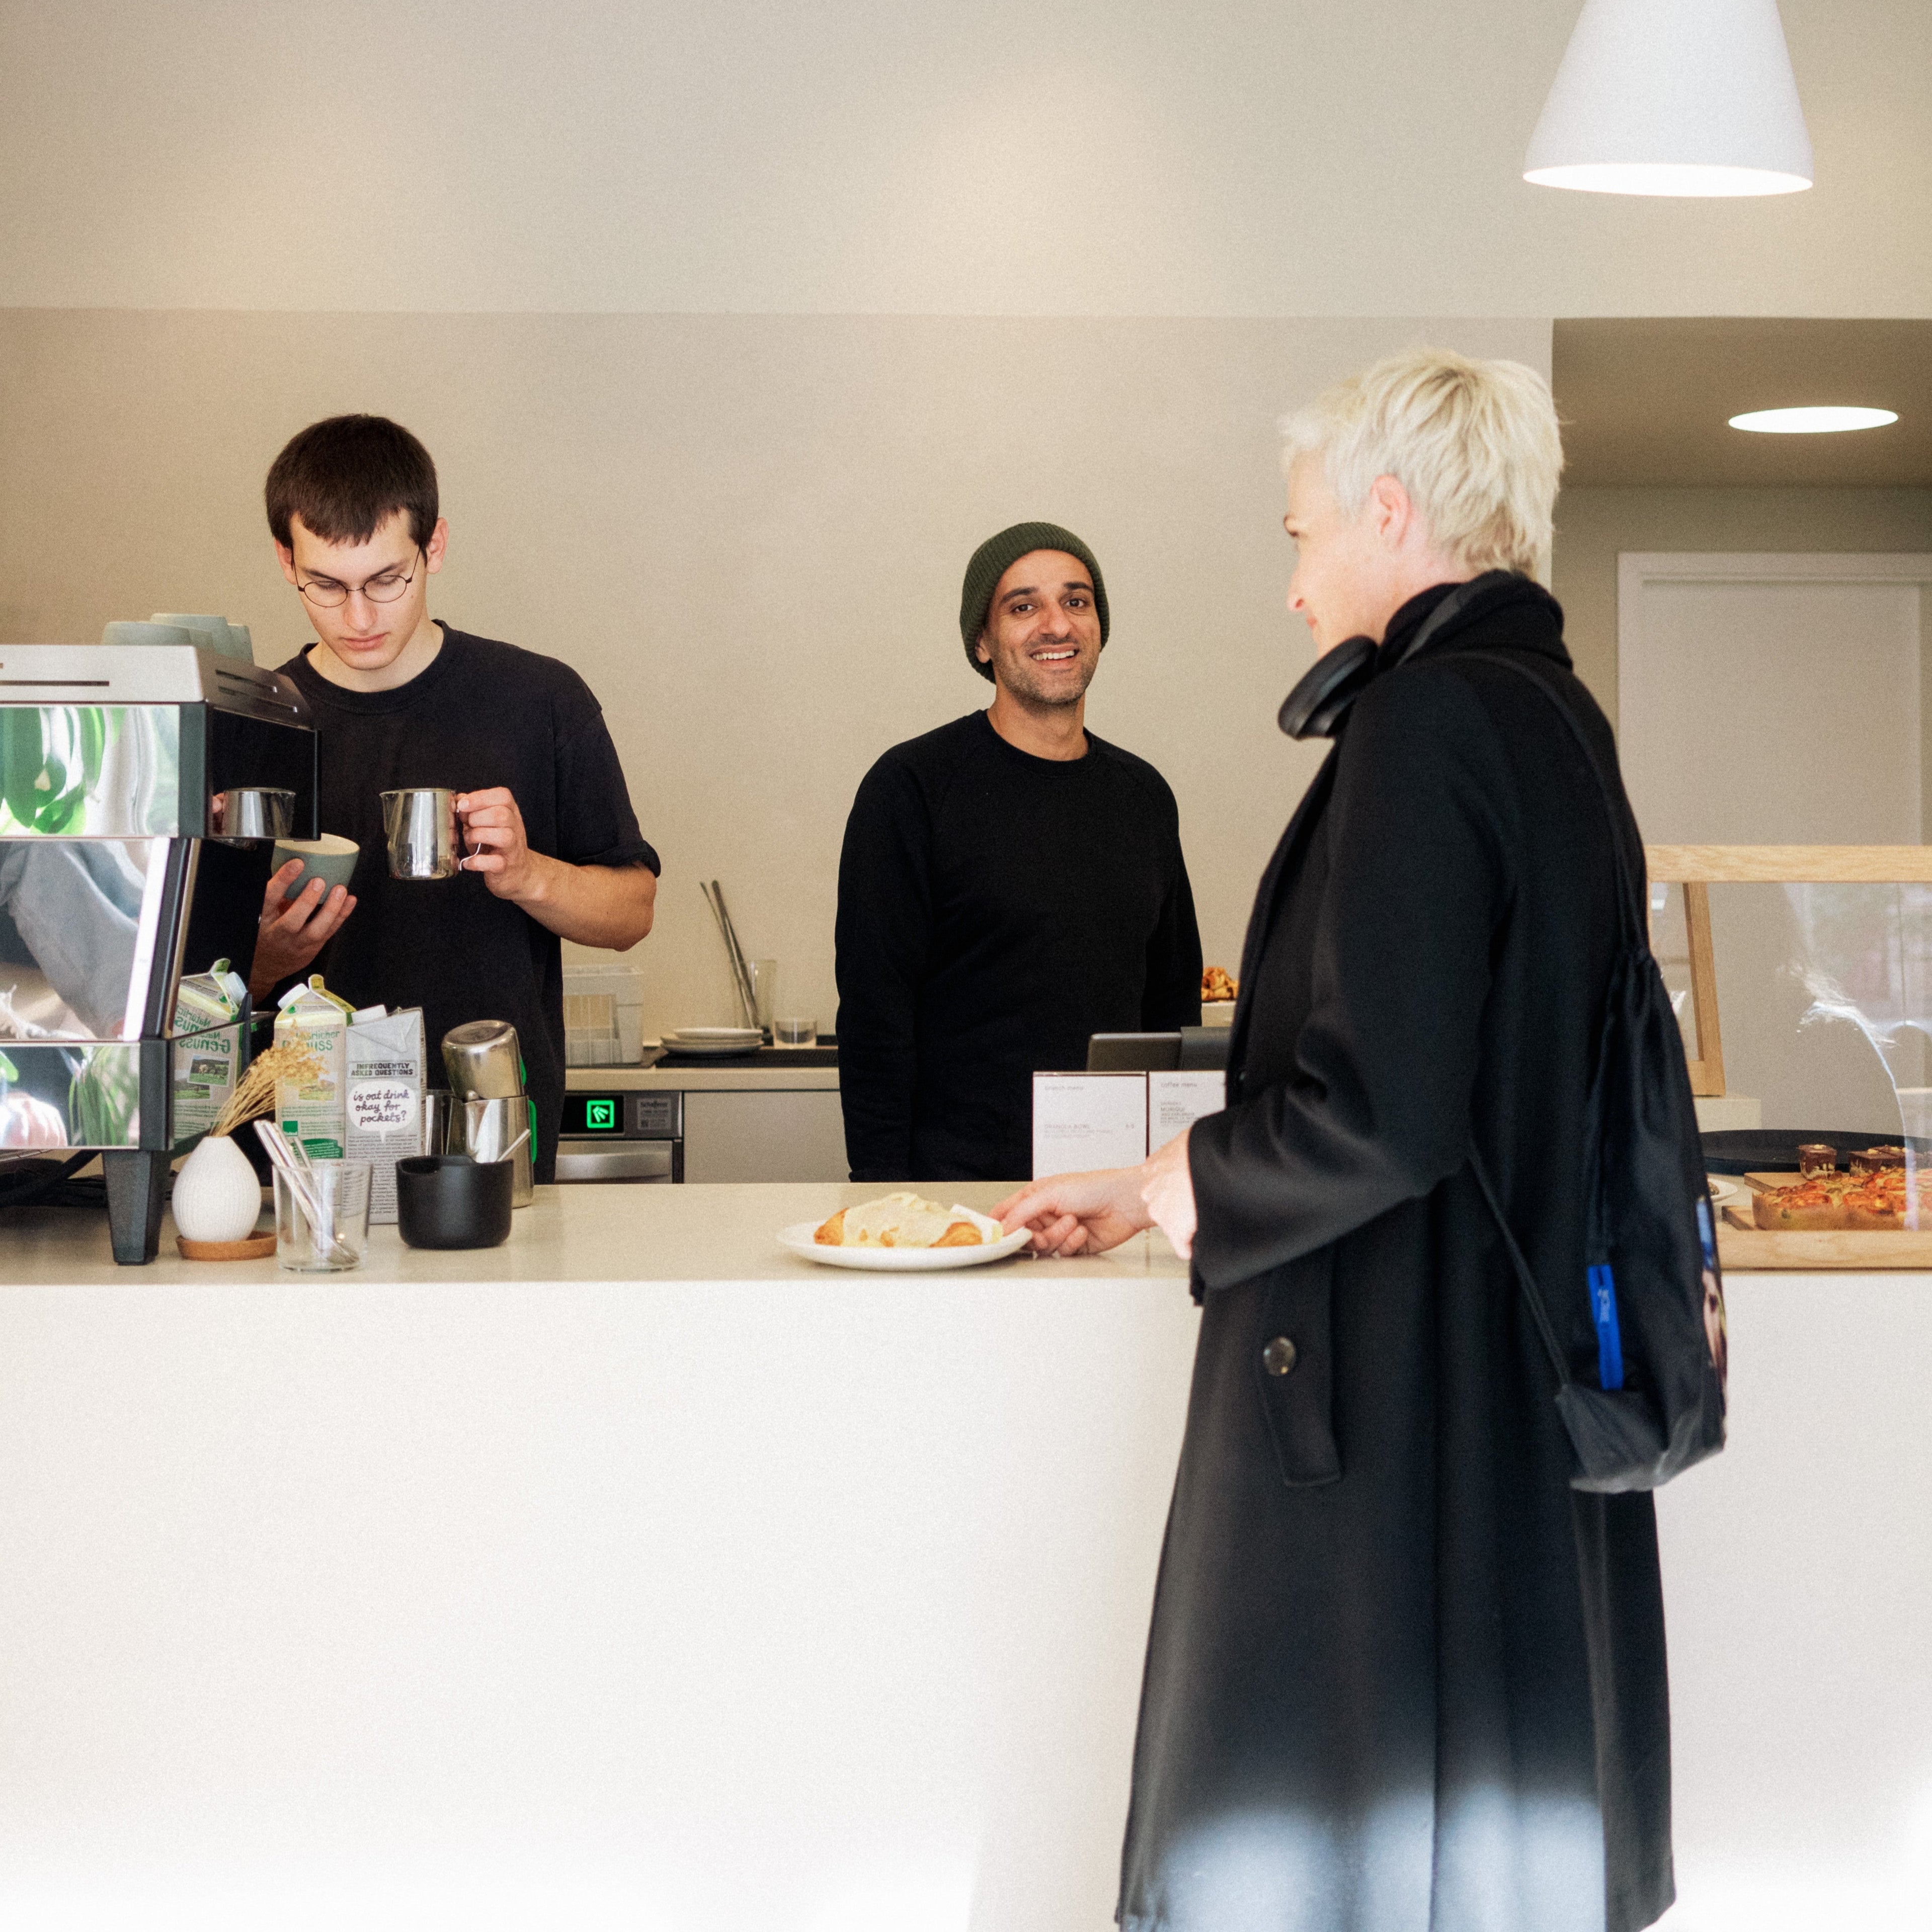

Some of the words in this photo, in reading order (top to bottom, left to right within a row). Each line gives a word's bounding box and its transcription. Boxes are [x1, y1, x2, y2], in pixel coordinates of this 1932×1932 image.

[353, 1091, 364, 1101] is
[366, 1090, 382, 1101] oat
[383, 1089, 410, 1099] drink
[355, 1101, 381, 1113] okay
[384, 1100, 401, 1112] for
[360, 1110, 407, 1126] pockets?
